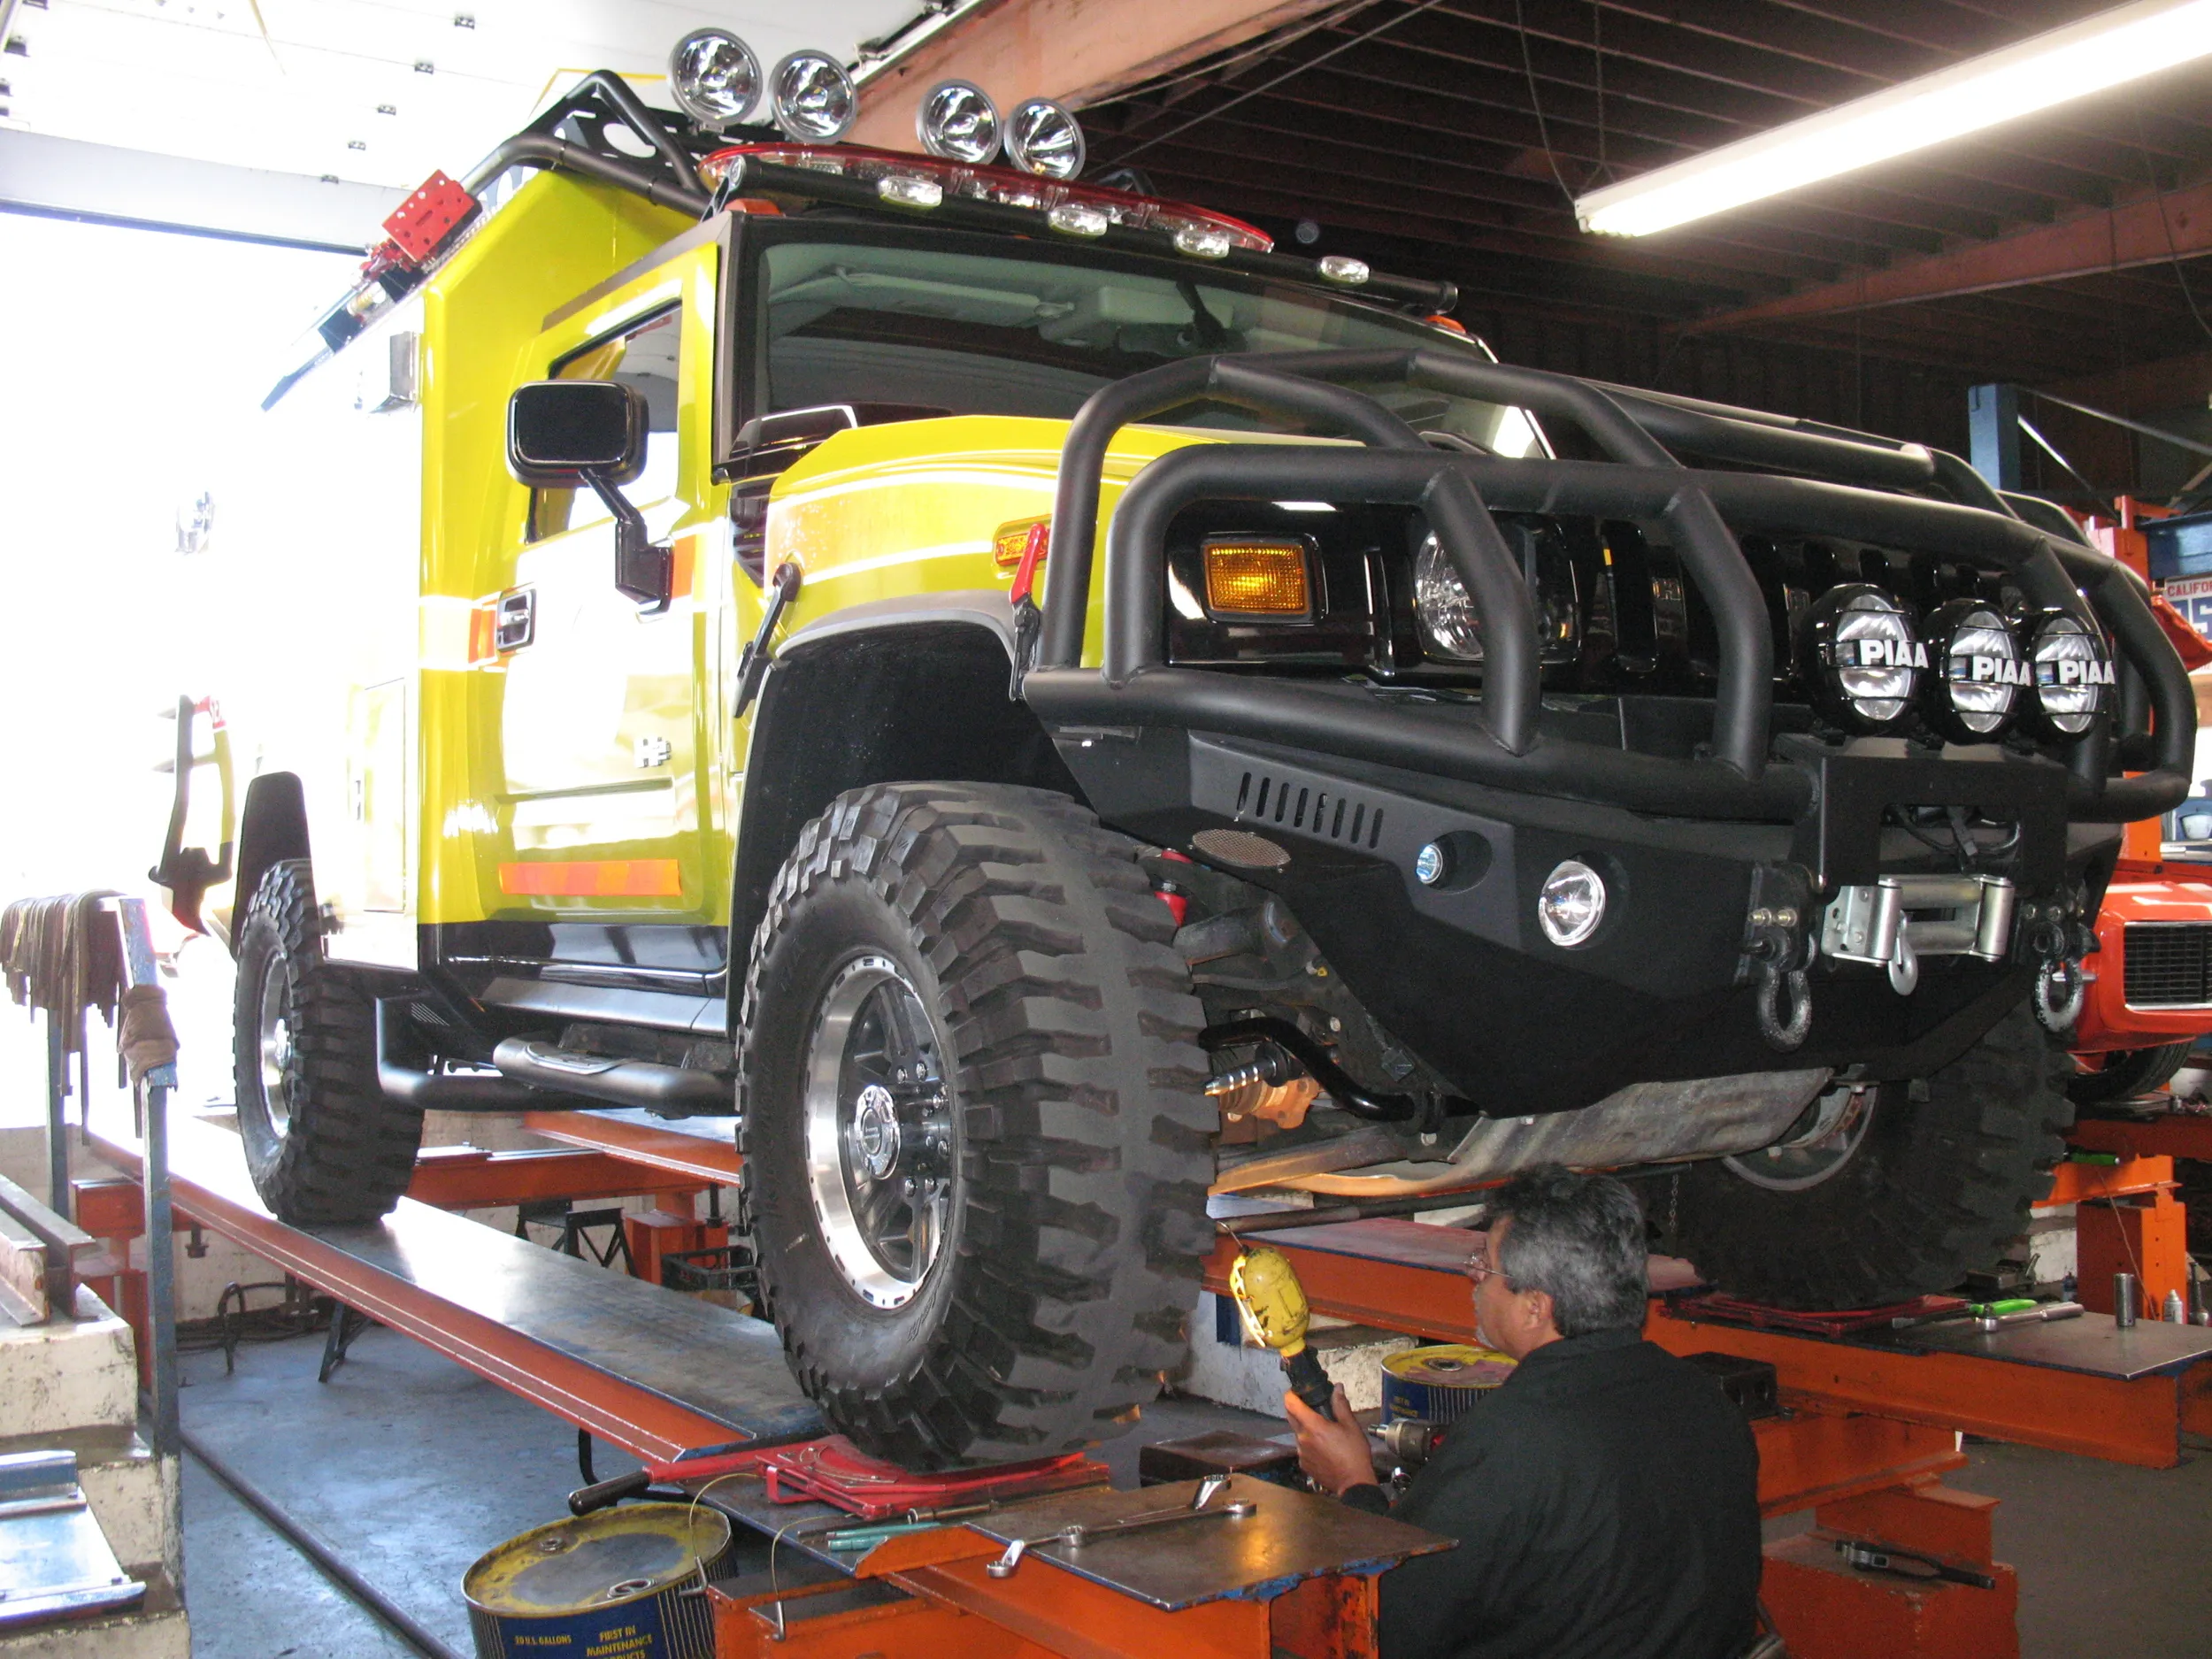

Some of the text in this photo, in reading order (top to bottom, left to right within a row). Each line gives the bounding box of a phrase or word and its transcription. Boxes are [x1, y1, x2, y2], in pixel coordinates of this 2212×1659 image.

[1860, 639, 1929, 669] PIAA
[1972, 656, 2032, 687] PIAA
[2058, 659, 2116, 685] PIAA
[539, 1633, 572, 1646] GALLONS
[587, 1633, 653, 1657] MAINTENANCE
[600, 1624, 636, 1642] FIRST IN
